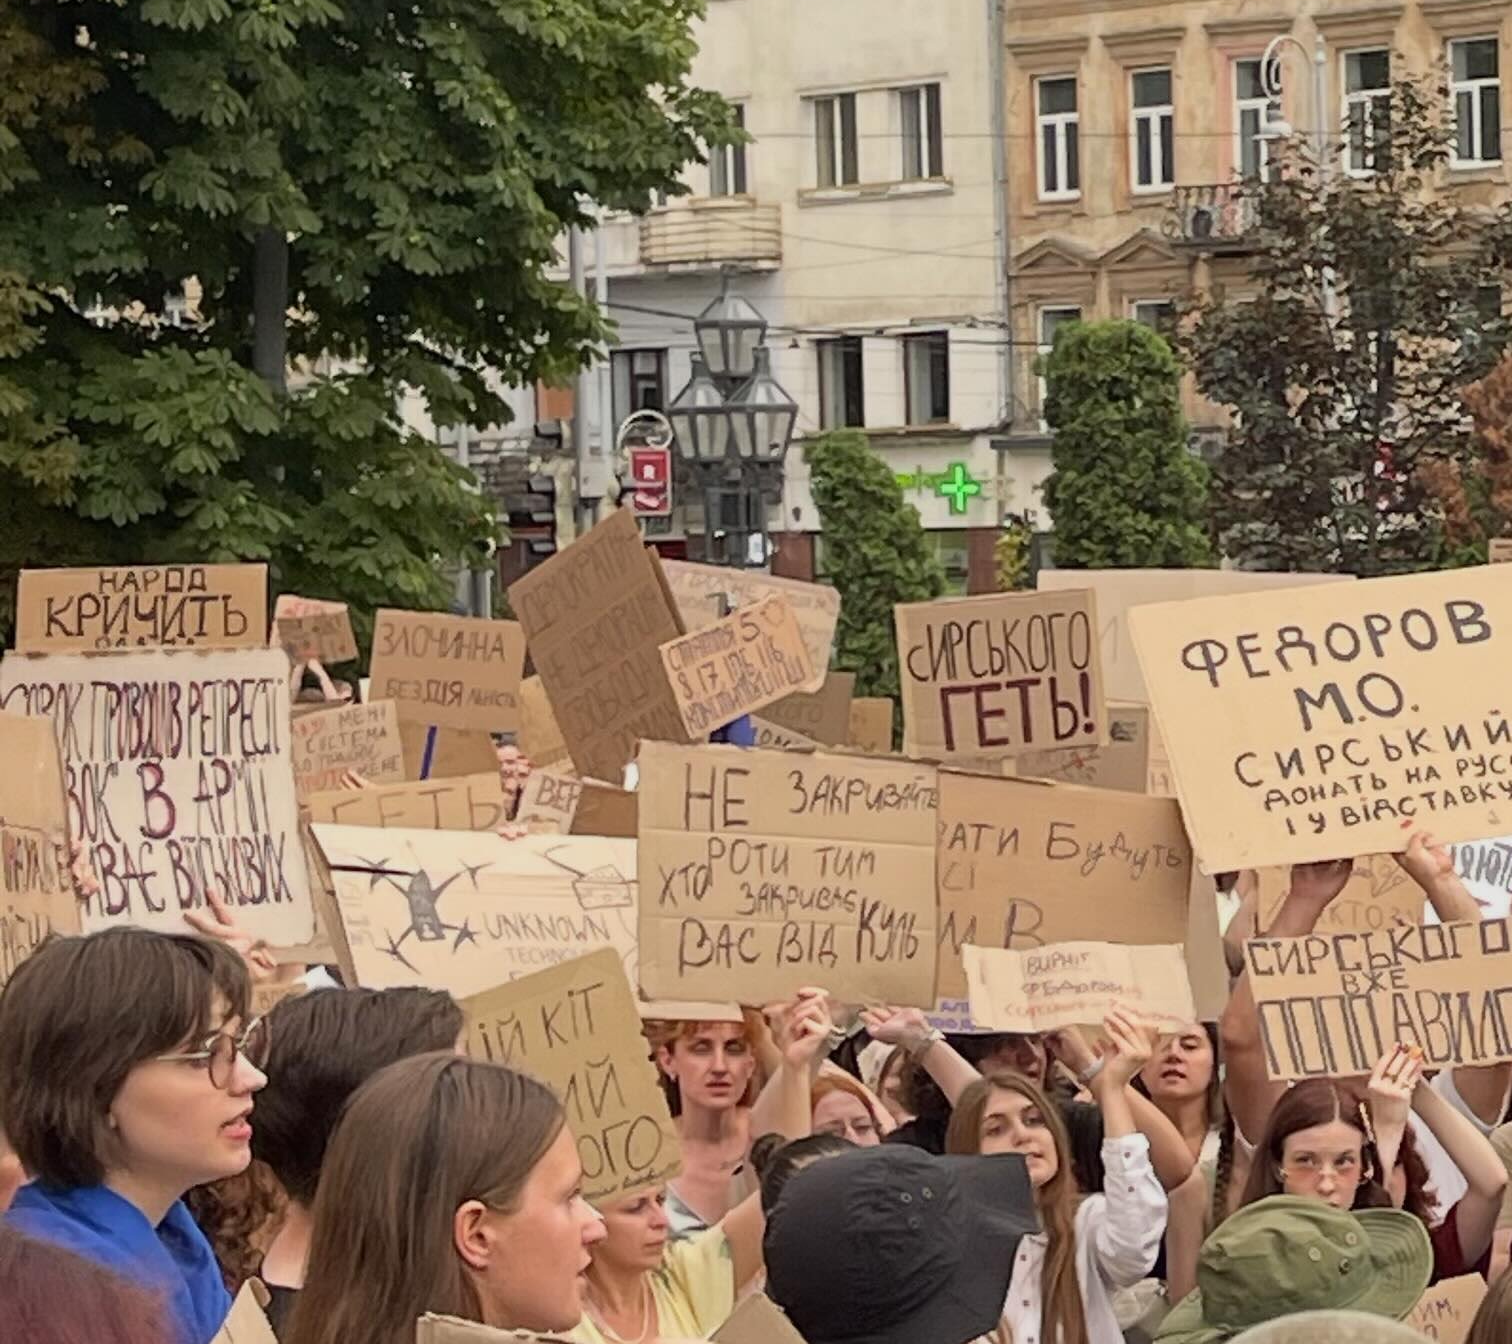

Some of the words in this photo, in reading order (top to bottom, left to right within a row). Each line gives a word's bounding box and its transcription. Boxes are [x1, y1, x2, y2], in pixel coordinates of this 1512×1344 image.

[99, 567, 208, 594] НАРОД
[45, 592, 249, 643] КРИЧИТЬ
[377, 622, 506, 662] ЗЛОЧИННА
[1181, 599, 1493, 688] ФЕДОРОВ
[907, 610, 1092, 682] СИРСЬКОГО
[940, 671, 1095, 752] ГЕТЬ!
[684, 763, 751, 831] НЕ
[1263, 772, 1388, 813] ДОНАТЬ
[1405, 765, 1442, 786] НА
[814, 845, 877, 879] ТИМ
[484, 910, 611, 946] UNKNOWN
[677, 917, 761, 978] ВАС
[776, 919, 839, 969] ВІД
[855, 897, 920, 964] КУЛЬ
[1246, 917, 1512, 977] СИРСЬКОГО
[1340, 967, 1411, 996] ВЖЕ
[540, 981, 605, 1048] КІТ
